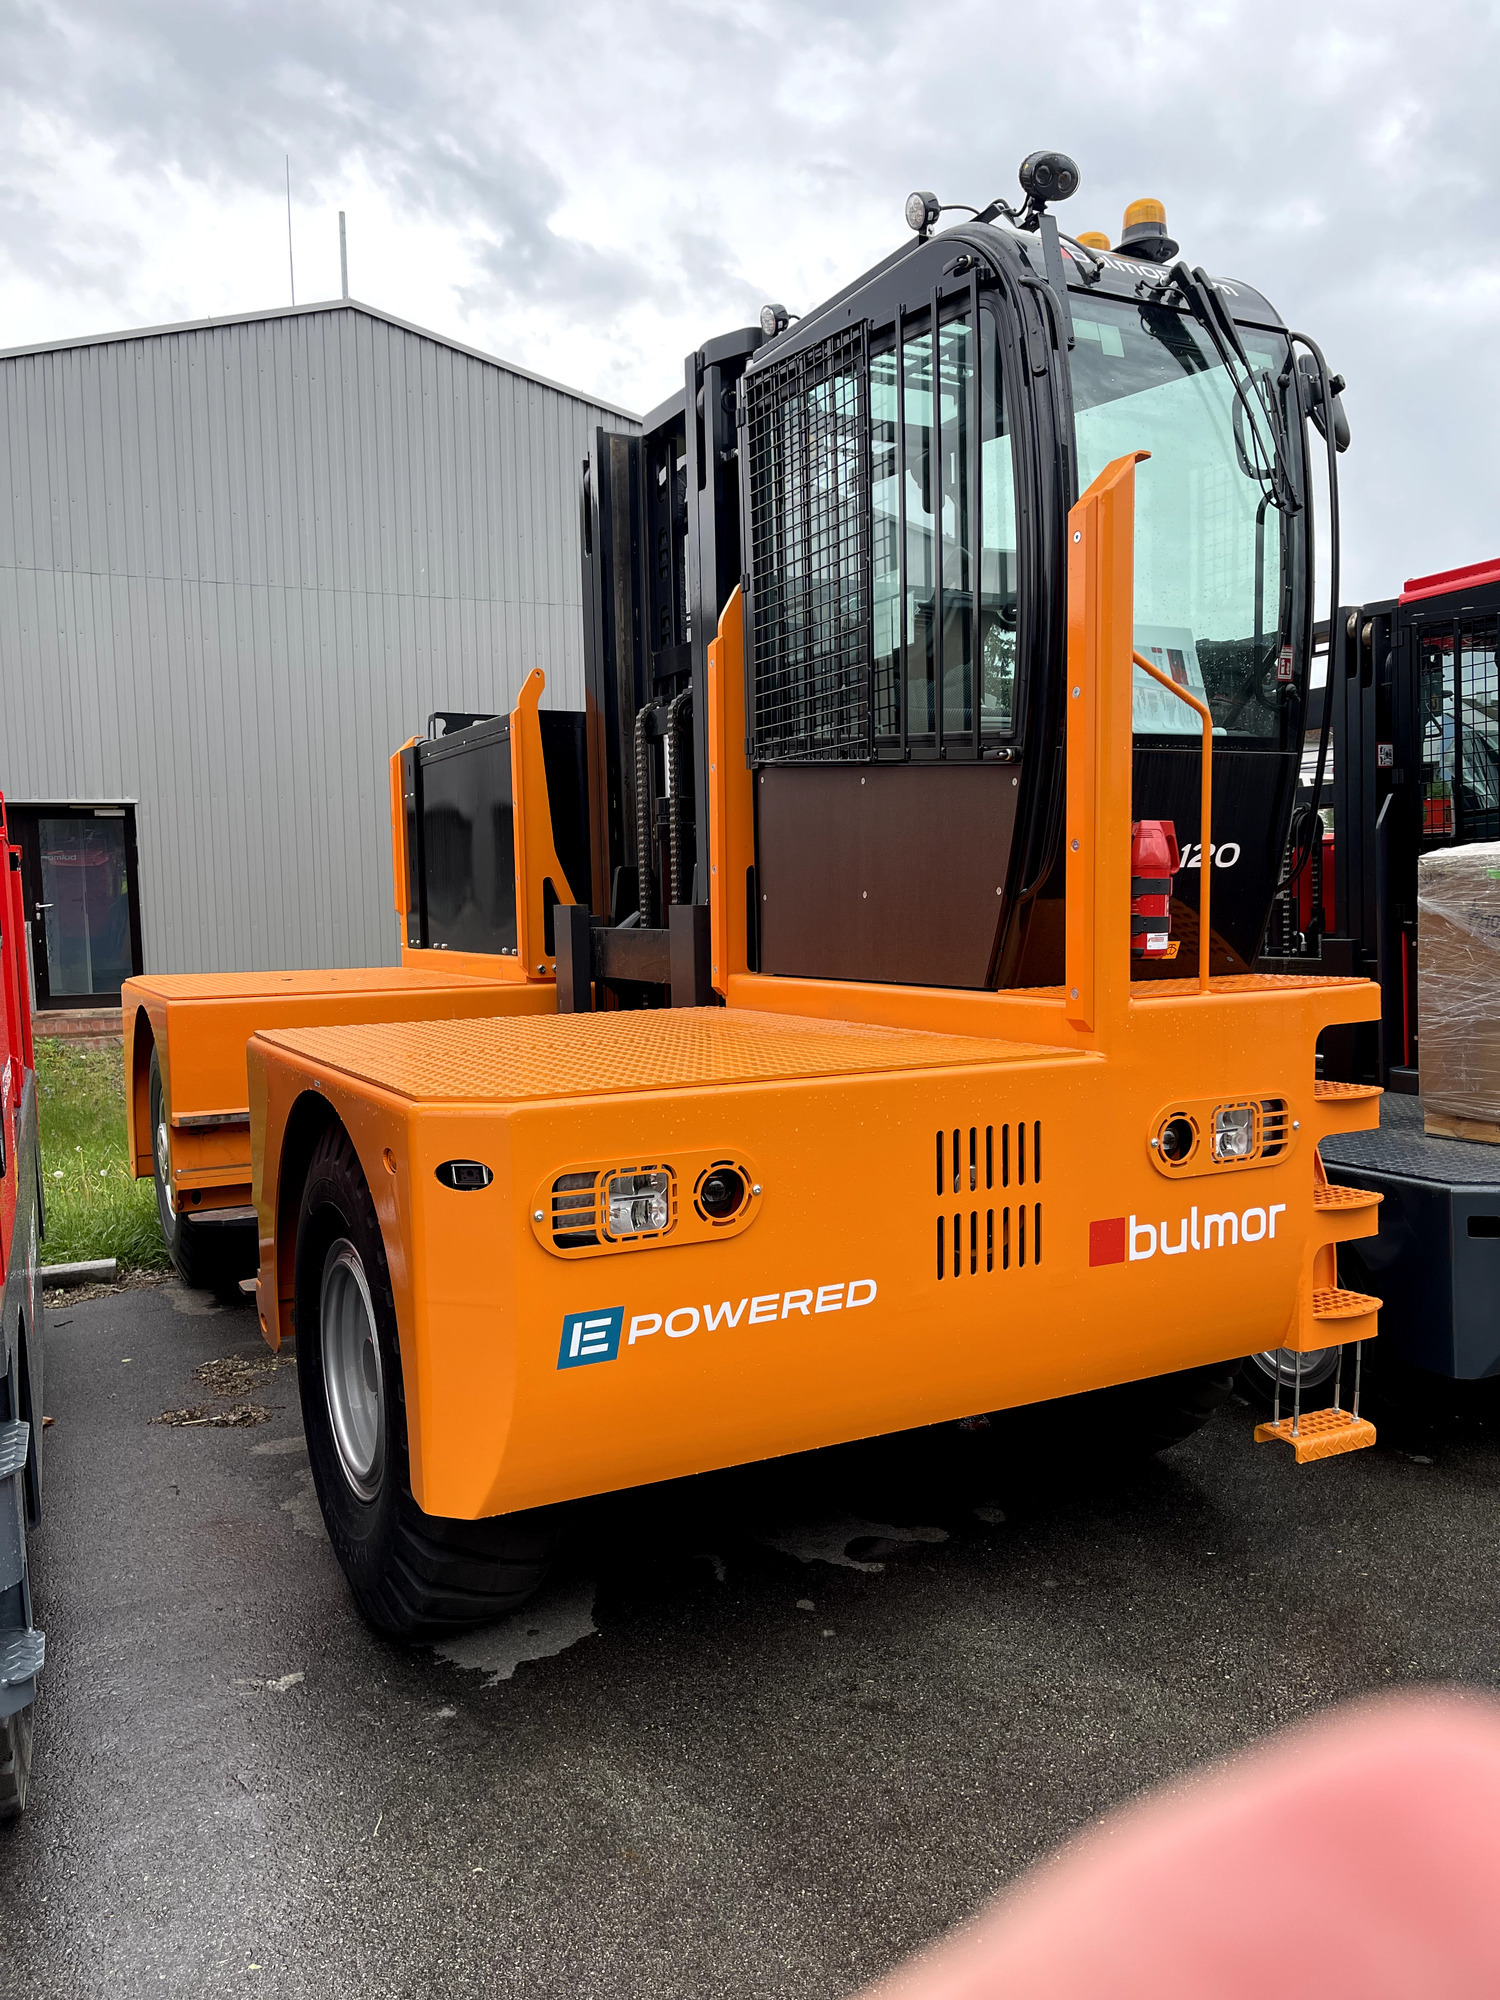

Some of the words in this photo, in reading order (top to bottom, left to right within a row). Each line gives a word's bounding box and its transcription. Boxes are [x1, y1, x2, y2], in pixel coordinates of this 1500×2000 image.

[1180, 842, 1241, 868] 120
[1129, 1203, 1286, 1261] bulmor
[627, 1278, 878, 1346] POWERED
